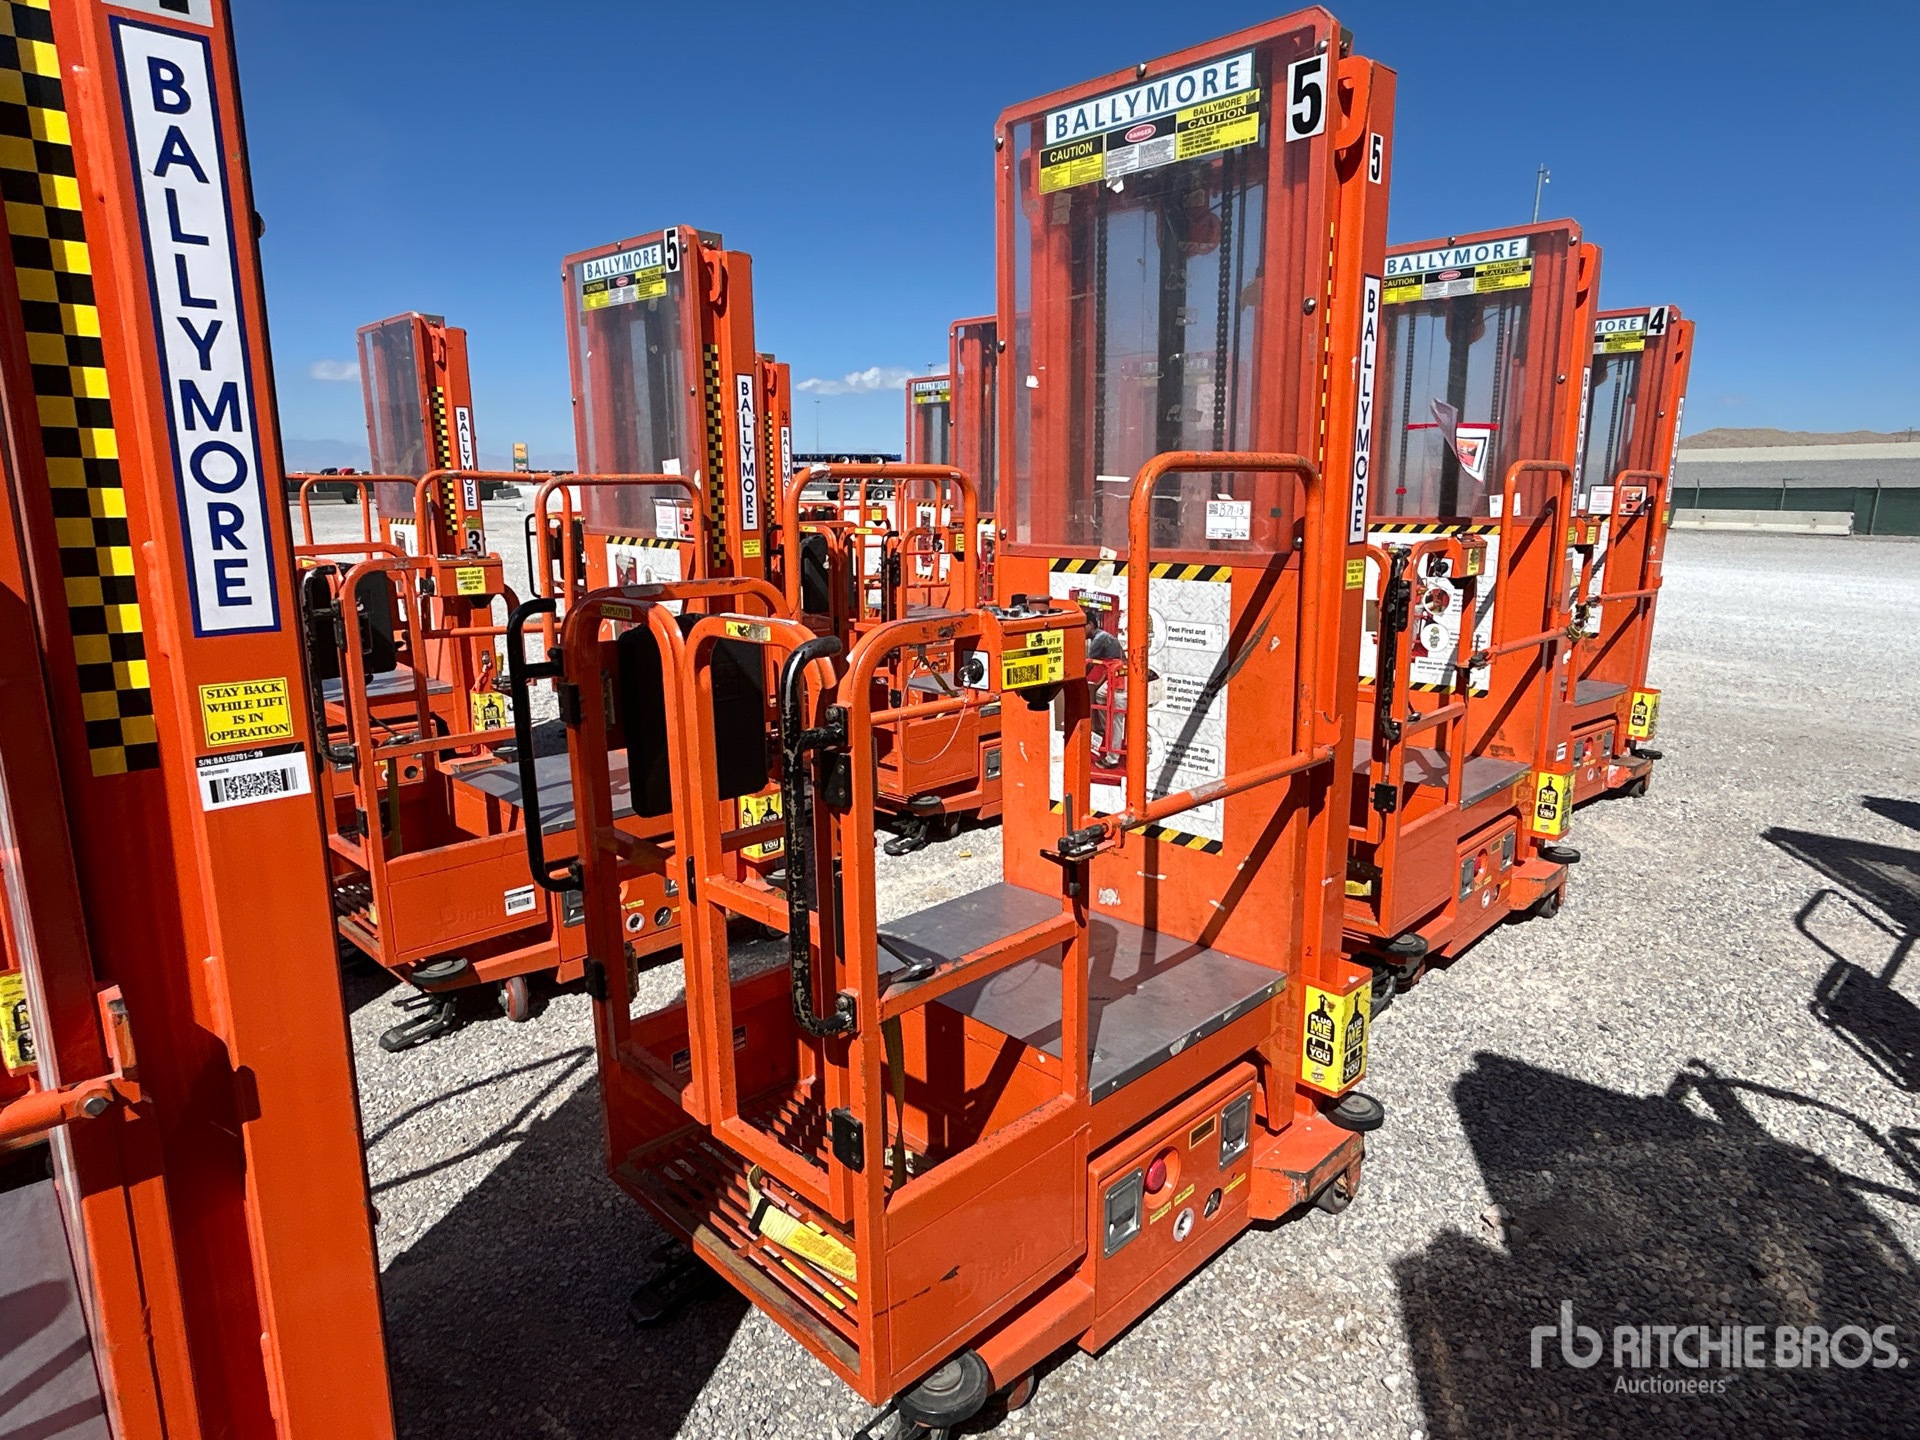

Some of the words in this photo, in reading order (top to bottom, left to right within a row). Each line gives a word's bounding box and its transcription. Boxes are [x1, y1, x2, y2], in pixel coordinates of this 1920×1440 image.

[1055, 60, 1240, 139] BALLYMORE
[1292, 58, 1322, 135] 5
[1193, 97, 1242, 117] BALLYMORE
[1188, 106, 1247, 129] CAUTION
[1049, 142, 1093, 163] CAUTION
[1371, 137, 1381, 181] 5
[667, 229, 678, 271] 5
[1387, 241, 1519, 274] BALLYMORE
[587, 248, 658, 278] BALLYMORE
[1483, 266, 1523, 277] CAUTION
[1649, 307, 1665, 334] 4
[146, 56, 253, 607] BALLYMORE
[1354, 288, 1376, 532] BALLYMORE
[741, 382, 755, 523] BALLYMORE
[468, 530, 481, 551] 3
[1168, 626, 1180, 634] Feet
[1181, 627, 1194, 635] First
[206, 687, 240, 699] STAY
[244, 682, 282, 695] BACK
[1167, 676, 1181, 685] Place
[1182, 678, 1191, 686] the
[1192, 679, 1205, 689] body
[1178, 687, 1194, 695] static
[206, 700, 253, 713] WHILE
[257, 696, 285, 708] LIFT
[1174, 695, 1192, 704] yellow
[1182, 704, 1191, 712] not
[232, 715, 246, 725] IS
[249, 712, 264, 723] IN
[210, 723, 289, 742] OPERATION
[1200, 746, 1210, 754] the
[1187, 761, 1211, 772] lanyard.
[1191, 754, 1216, 763] attached
[199, 768, 229, 777] Ballymore
[763, 840, 779, 850] YOU
[1310, 1014, 1332, 1027] PLUG
[1310, 1022, 1332, 1035] ME
[1347, 1017, 1363, 1033] PLUG
[1346, 1028, 1362, 1044] ME
[1309, 1048, 1331, 1062] YOU
[1344, 1060, 1361, 1076] YOU
